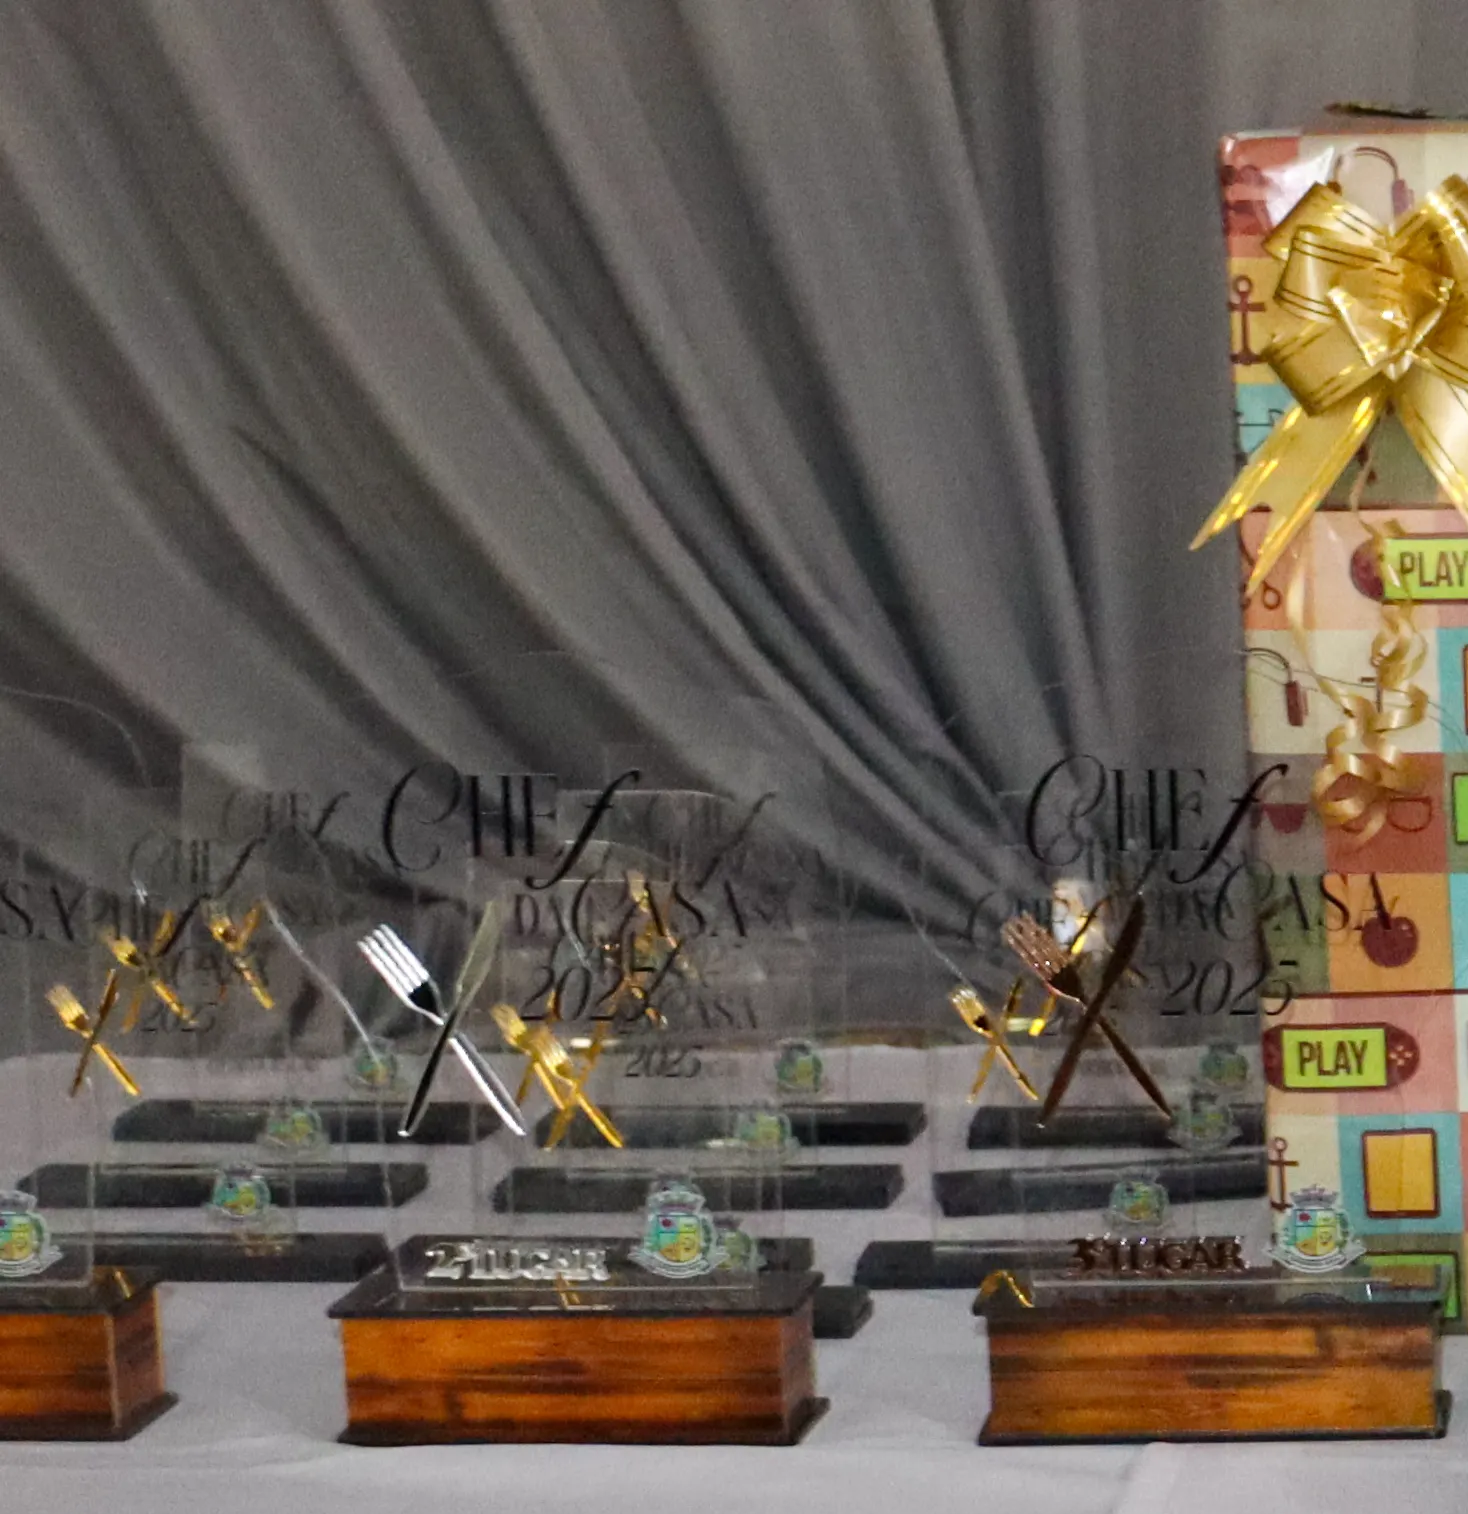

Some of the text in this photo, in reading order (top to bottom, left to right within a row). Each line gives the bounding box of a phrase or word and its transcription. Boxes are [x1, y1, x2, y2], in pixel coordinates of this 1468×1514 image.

[0, 881, 78, 943] SA
[519, 966, 658, 1022] 2025
[1160, 958, 1299, 1016] 2025
[1298, 1039, 1369, 1077] PLAY
